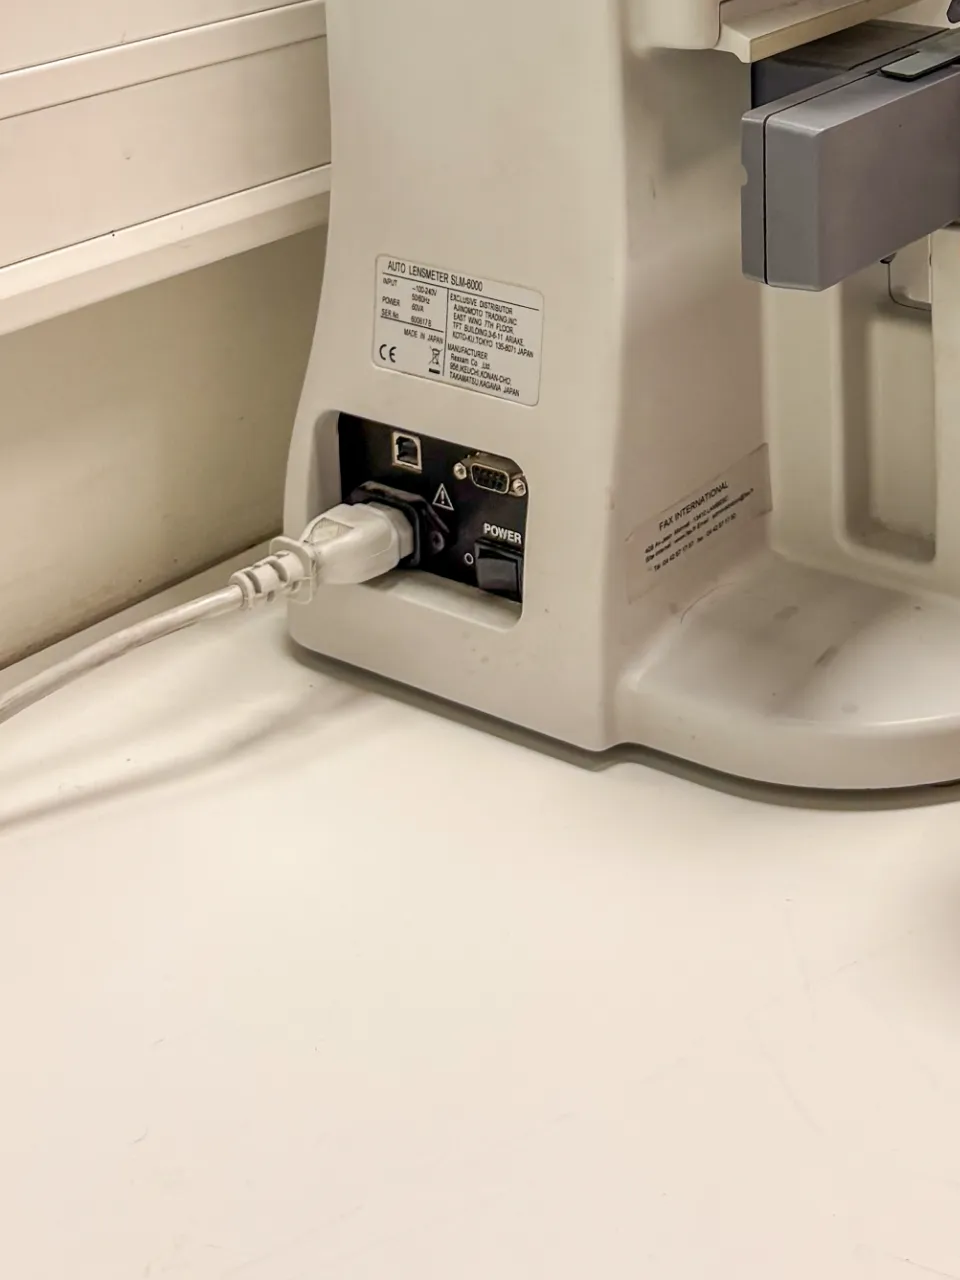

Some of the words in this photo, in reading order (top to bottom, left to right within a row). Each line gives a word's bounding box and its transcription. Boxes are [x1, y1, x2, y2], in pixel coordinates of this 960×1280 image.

[387, 260, 406, 274] AUTO
[409, 265, 449, 283] LENSMETER
[450, 274, 483, 292] SLM-6000
[381, 295, 400, 307] POWER
[449, 293, 477, 306] EXCLUSIVE
[479, 300, 513, 315] DISTRIBUTOR
[453, 312, 467, 322] EAST
[403, 327, 418, 339] MADE
[428, 334, 444, 344] JAPAN
[379, 343, 397, 363] CE
[447, 342, 488, 360] MANUFACTURER
[517, 347, 534, 358] JAPAN
[503, 386, 520, 397] JAPAN
[659, 515, 674, 532] FAX
[674, 480, 729, 522] INTERNATIONAL
[483, 522, 522, 545] POWER
